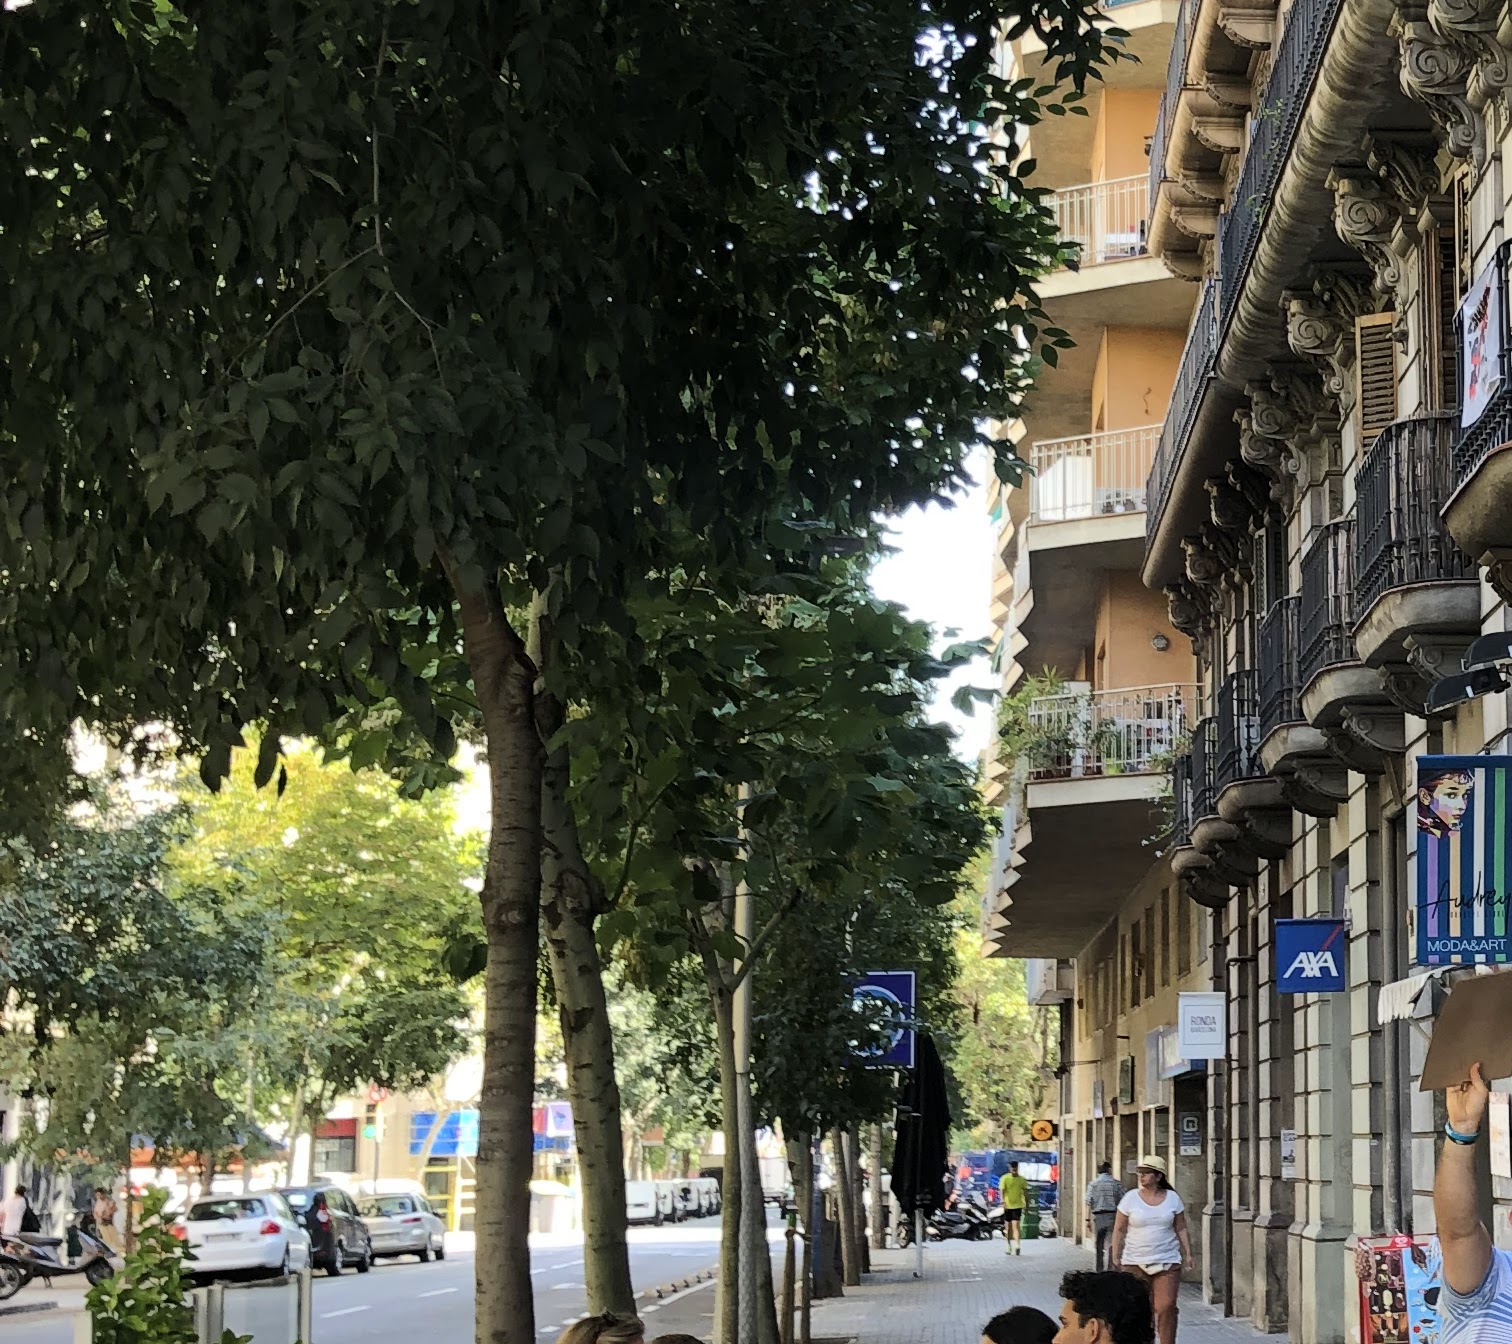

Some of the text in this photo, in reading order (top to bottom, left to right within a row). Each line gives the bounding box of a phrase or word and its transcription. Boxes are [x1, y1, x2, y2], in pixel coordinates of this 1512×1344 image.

[1418, 870, 1512, 936] Audrey
[1426, 938, 1508, 952] MODA&ART
[1282, 950, 1340, 979] AXA
